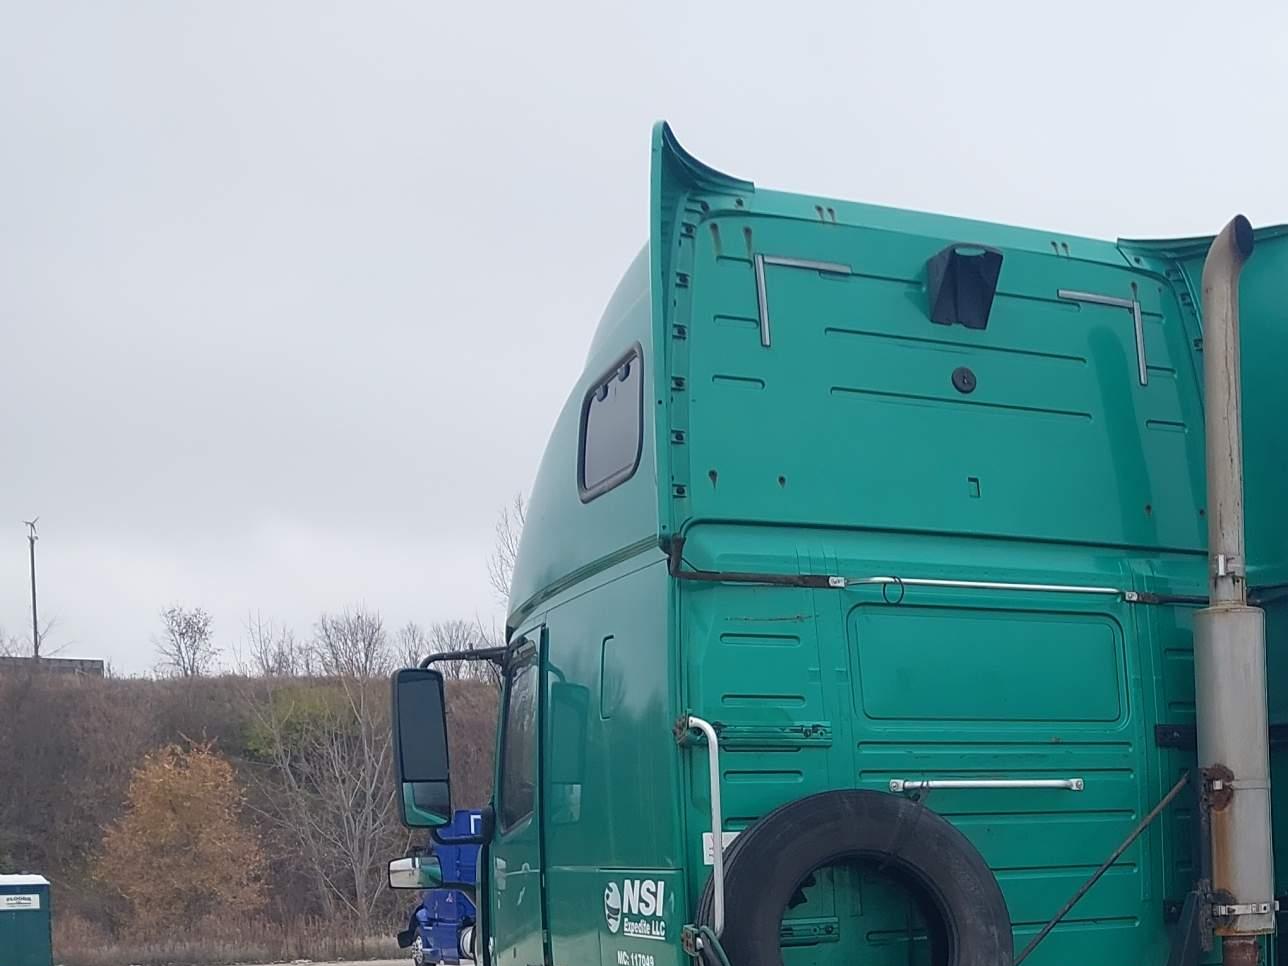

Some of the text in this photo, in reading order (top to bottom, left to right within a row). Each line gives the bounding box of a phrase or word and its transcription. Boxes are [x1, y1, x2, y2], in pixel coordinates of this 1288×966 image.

[623, 879, 664, 916] NSI
[624, 917, 666, 936] Expedite LLC
[617, 950, 630, 966] MC:
